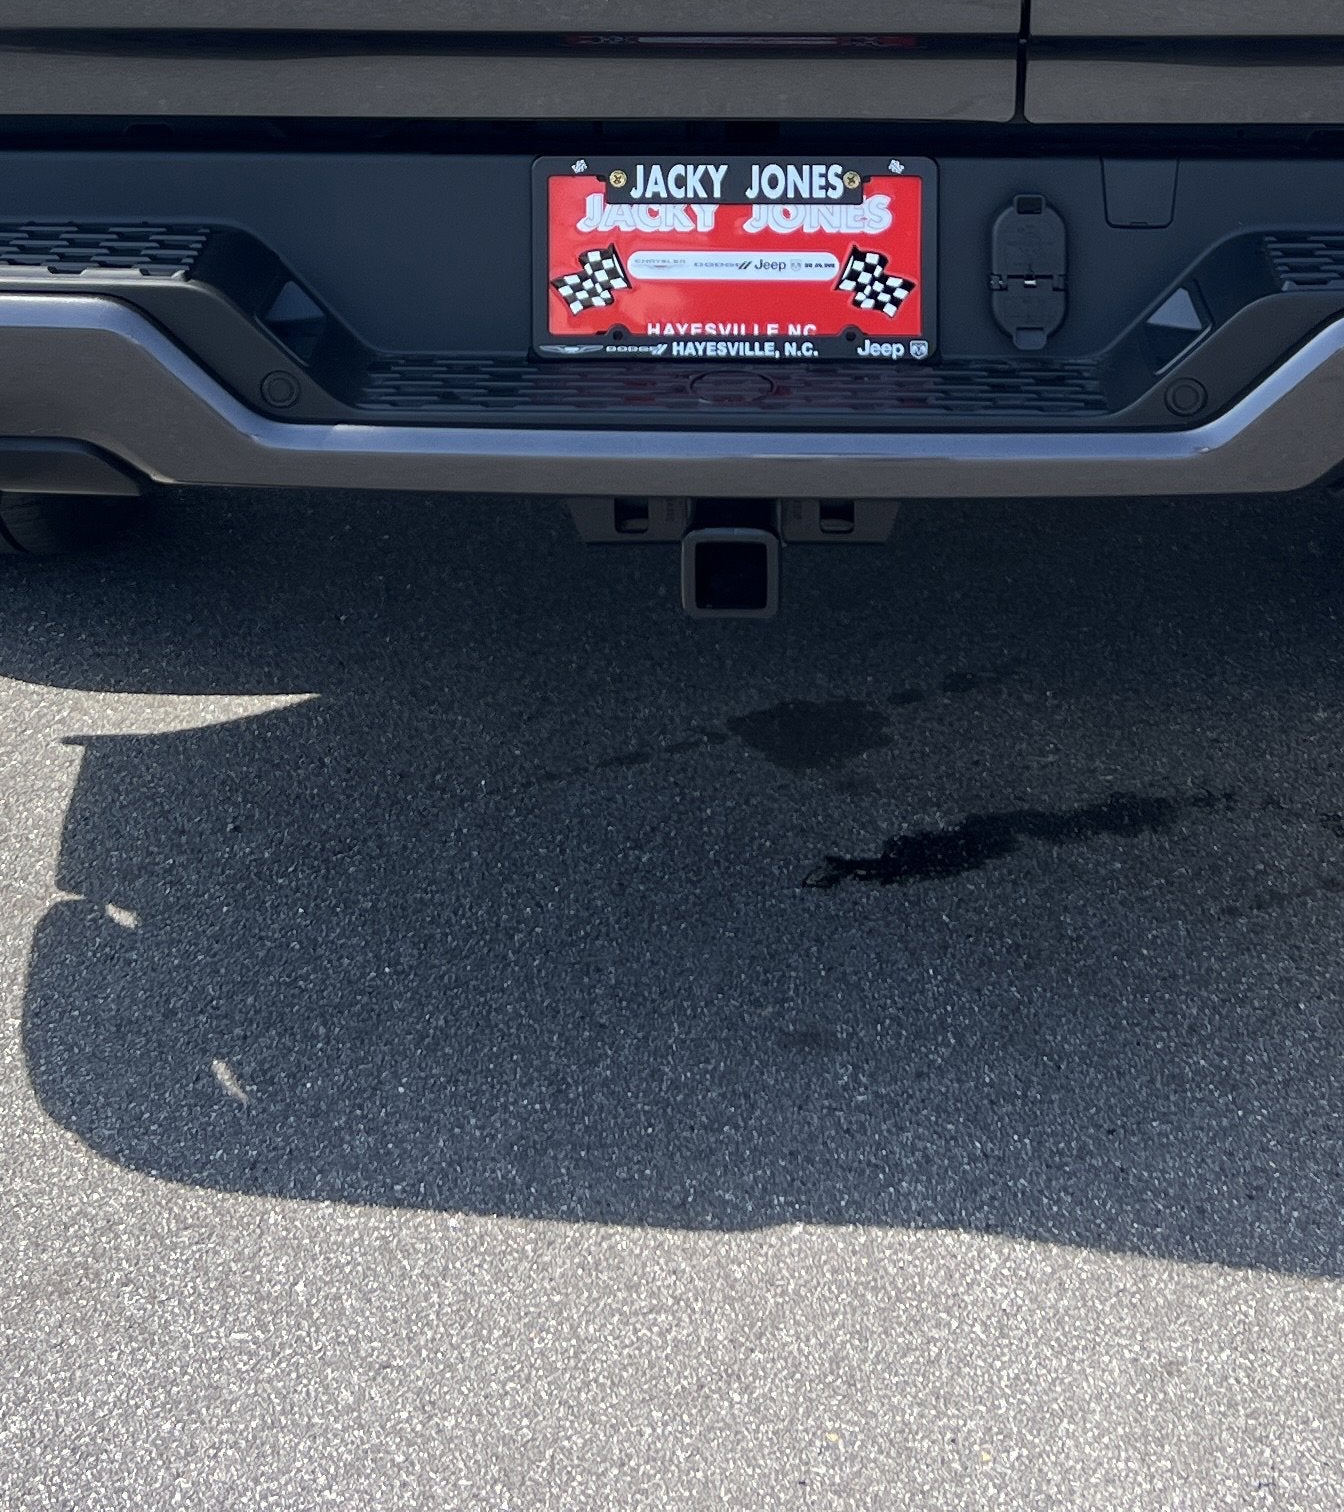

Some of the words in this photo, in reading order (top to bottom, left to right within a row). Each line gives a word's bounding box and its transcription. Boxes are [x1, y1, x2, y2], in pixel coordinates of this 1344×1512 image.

[629, 163, 729, 199] JACKY
[745, 163, 845, 200] JONES
[576, 193, 720, 233] JACKY
[742, 194, 893, 235] JONES
[754, 259, 787, 271] Jeep
[672, 341, 780, 359] HAYESVILLE,
[784, 341, 819, 357] N.C.
[857, 339, 905, 360] Jeep
